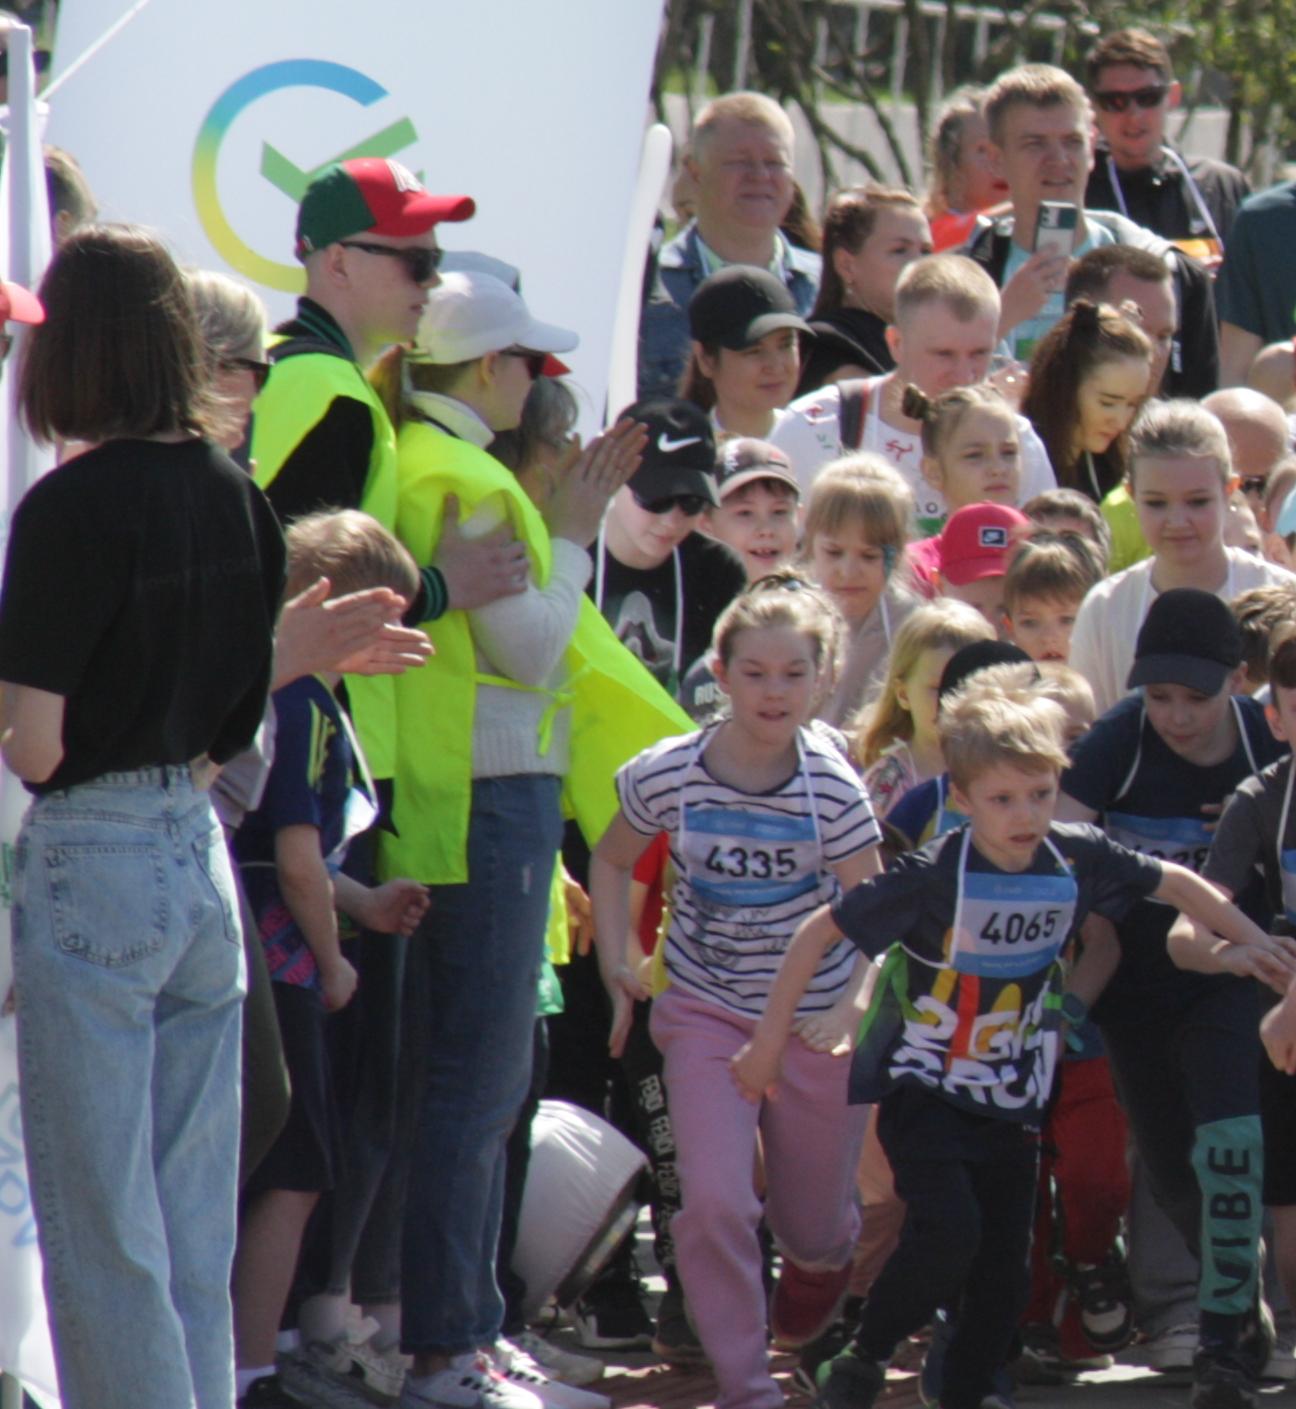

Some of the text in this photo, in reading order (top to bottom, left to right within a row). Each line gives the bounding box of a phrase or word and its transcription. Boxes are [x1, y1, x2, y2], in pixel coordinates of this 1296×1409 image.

[705, 845, 797, 879] 4335
[980, 909, 1062, 945] 4065
[1207, 1147, 1251, 1298] VIBE
